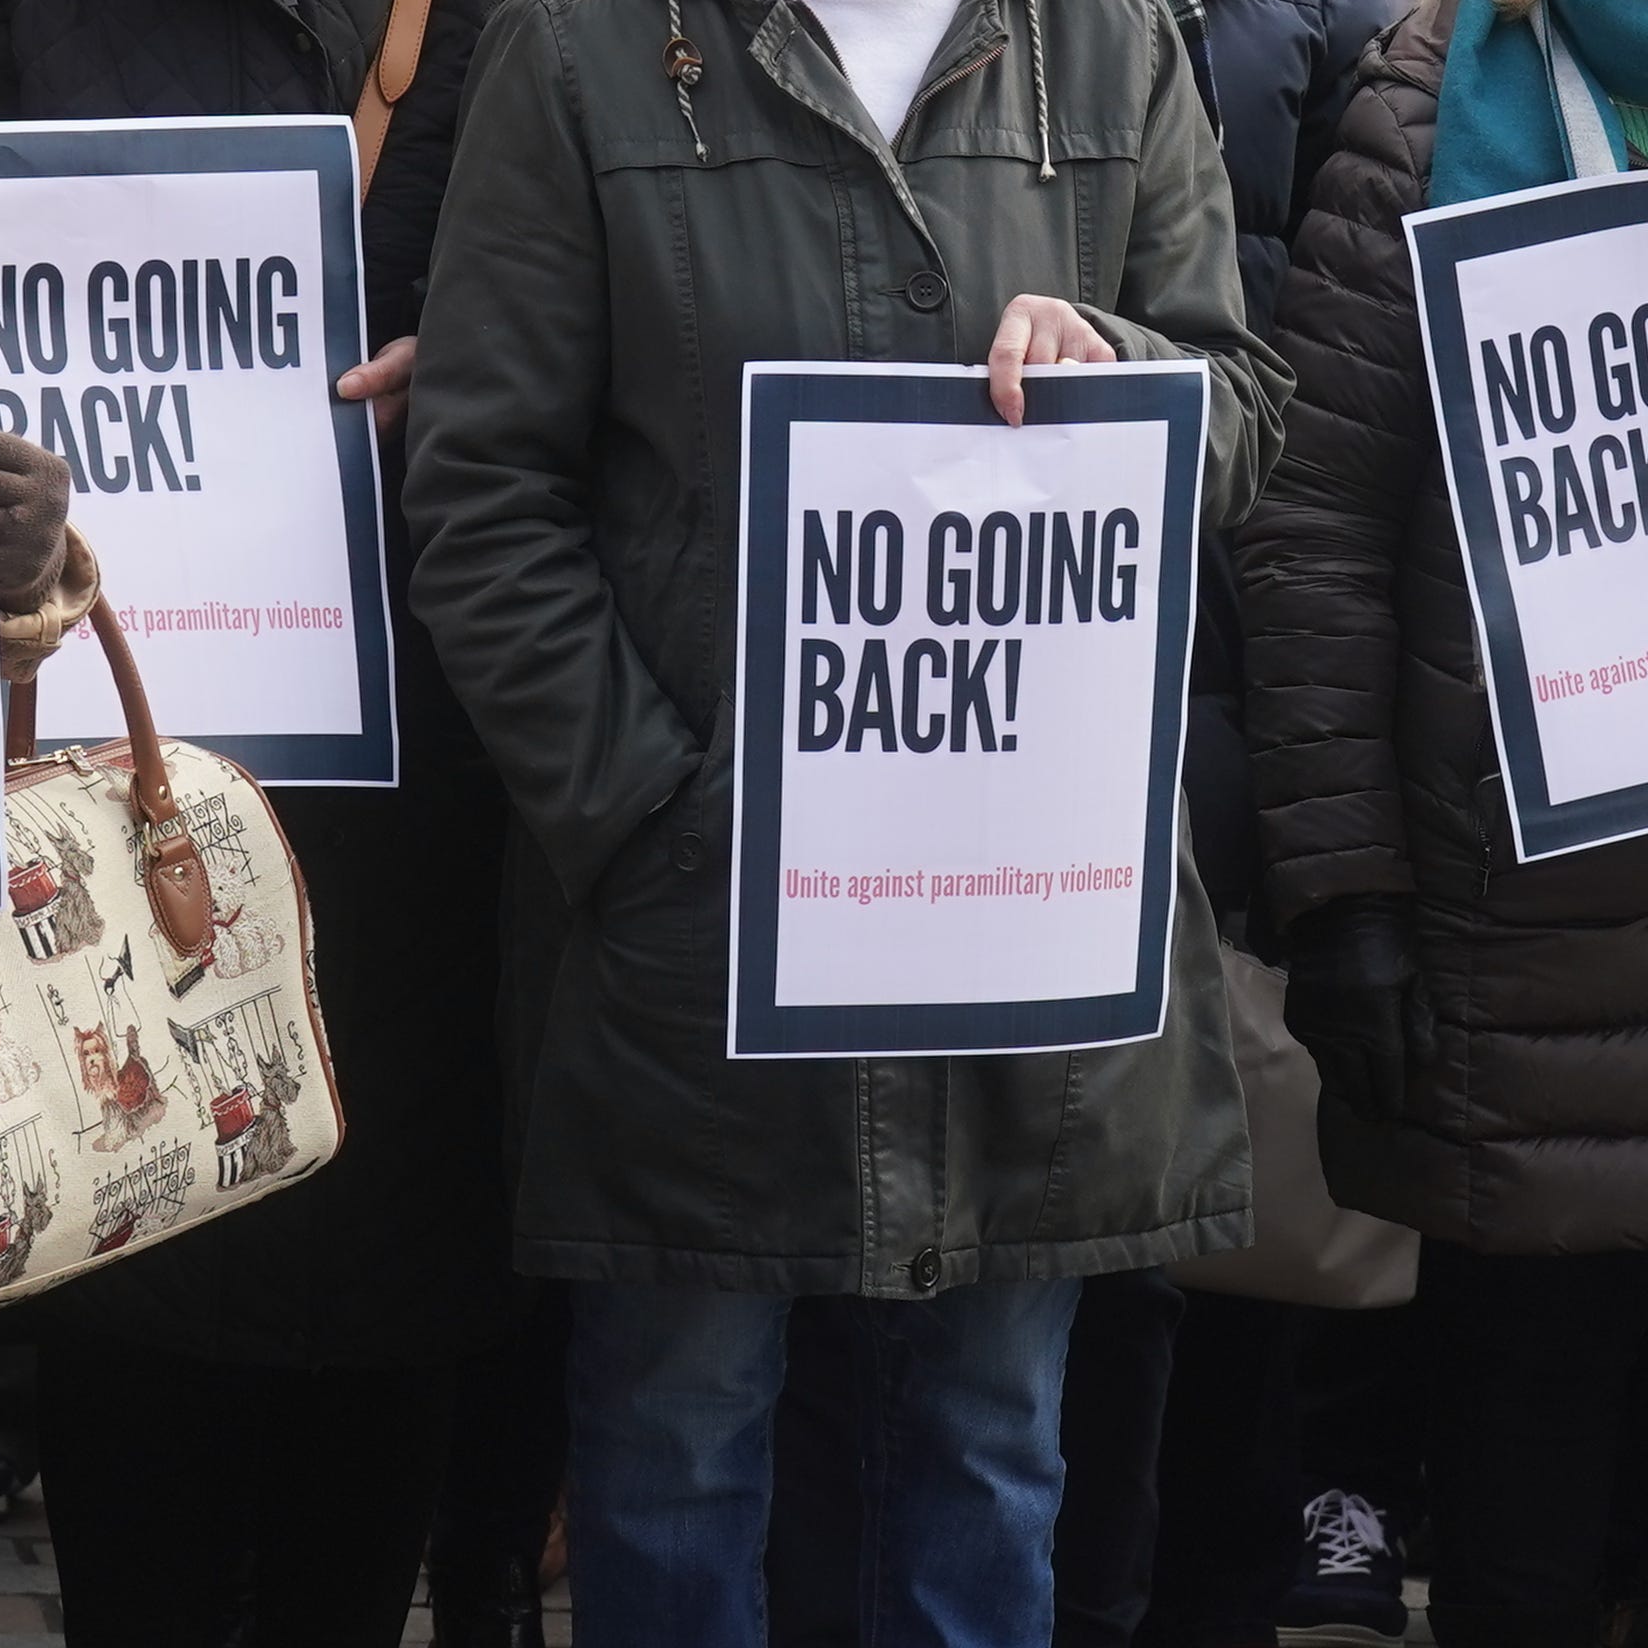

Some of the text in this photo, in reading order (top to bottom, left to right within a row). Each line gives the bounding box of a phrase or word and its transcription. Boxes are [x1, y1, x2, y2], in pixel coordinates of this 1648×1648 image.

[88, 256, 300, 373] GOING
[1481, 326, 1576, 446] NO
[144, 607, 260, 636] paramilitary
[269, 605, 343, 629] violence
[802, 508, 1139, 626] NO GOING
[798, 638, 1021, 753] BACK!
[1536, 671, 1585, 703] Unite
[785, 865, 1133, 906] Unite against paramilitary violence
